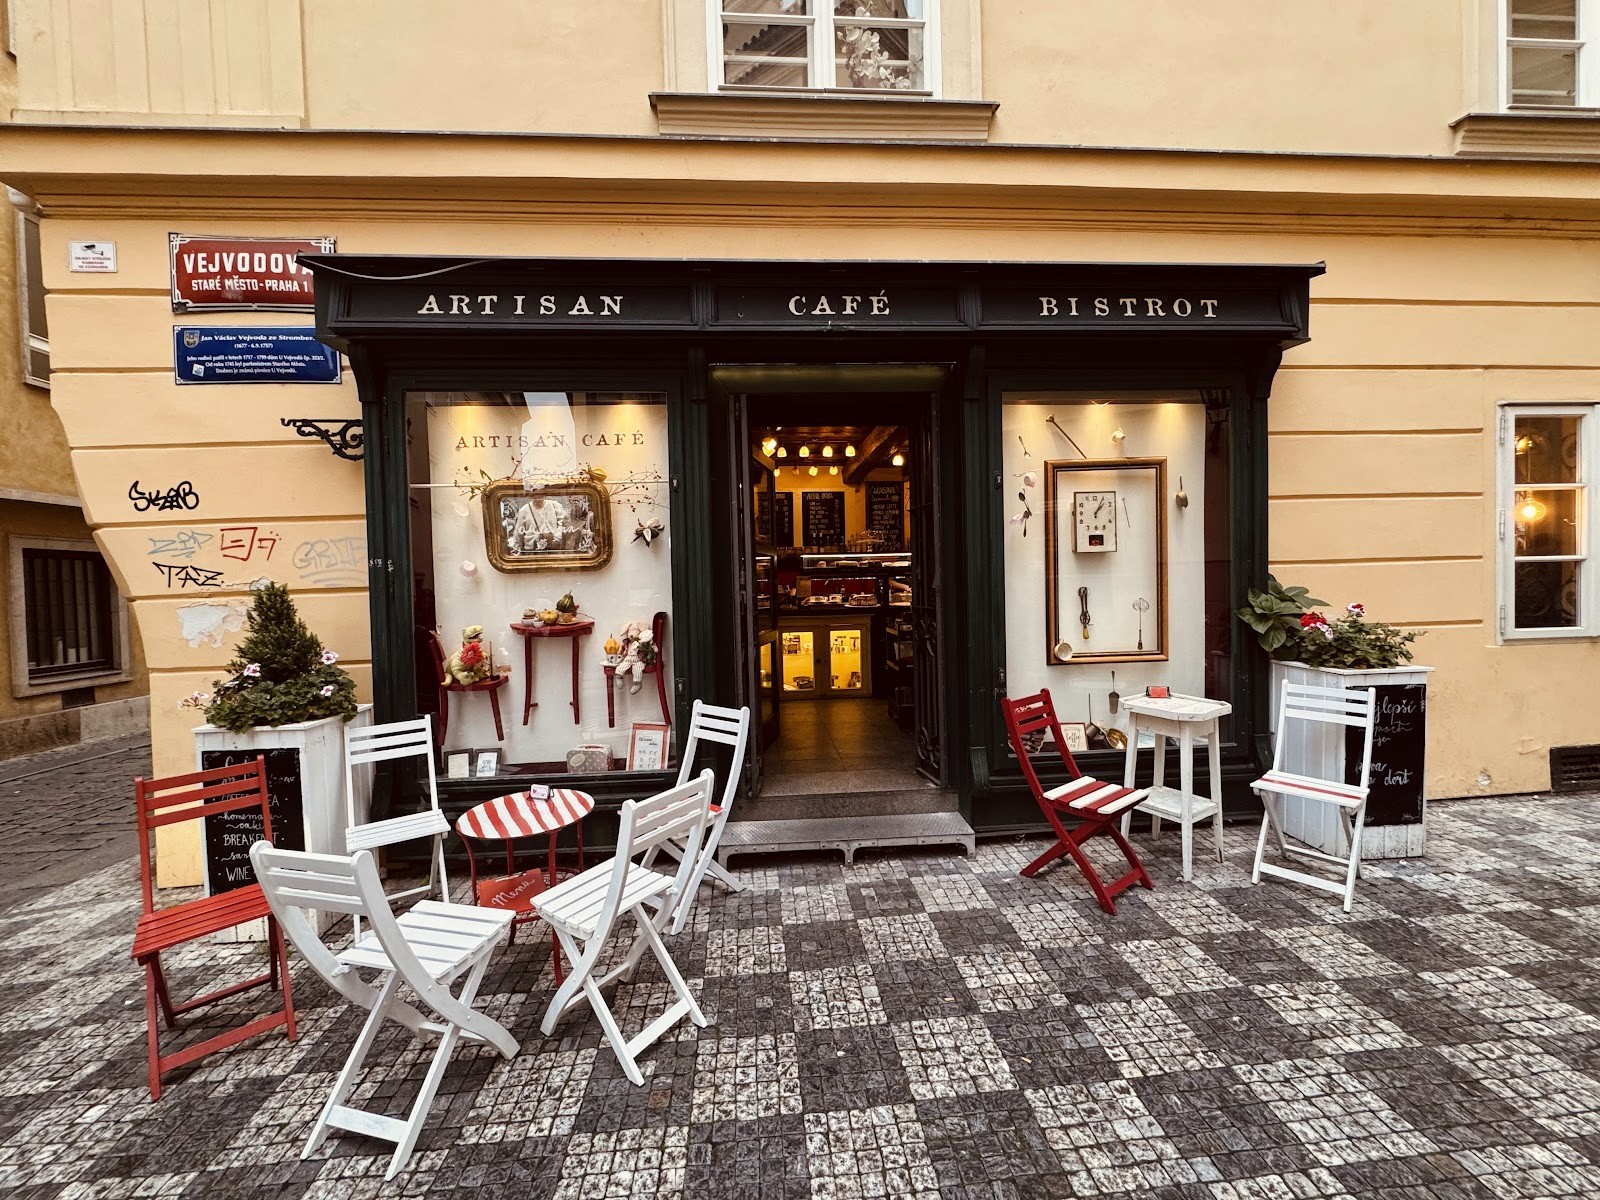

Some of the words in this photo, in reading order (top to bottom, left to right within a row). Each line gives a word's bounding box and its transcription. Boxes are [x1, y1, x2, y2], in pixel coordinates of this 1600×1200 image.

[192, 275, 222, 290] STARÉ
[303, 280, 309, 292] 1
[417, 294, 624, 316] ARTISAN
[788, 289, 890, 316] CAFÉ
[1038, 297, 1218, 318] BISTROT
[456, 434, 566, 448] ARTISAN
[582, 430, 645, 446] CAFÉ
[226, 866, 252, 882] WINE
[491, 878, 535, 906] Menu
